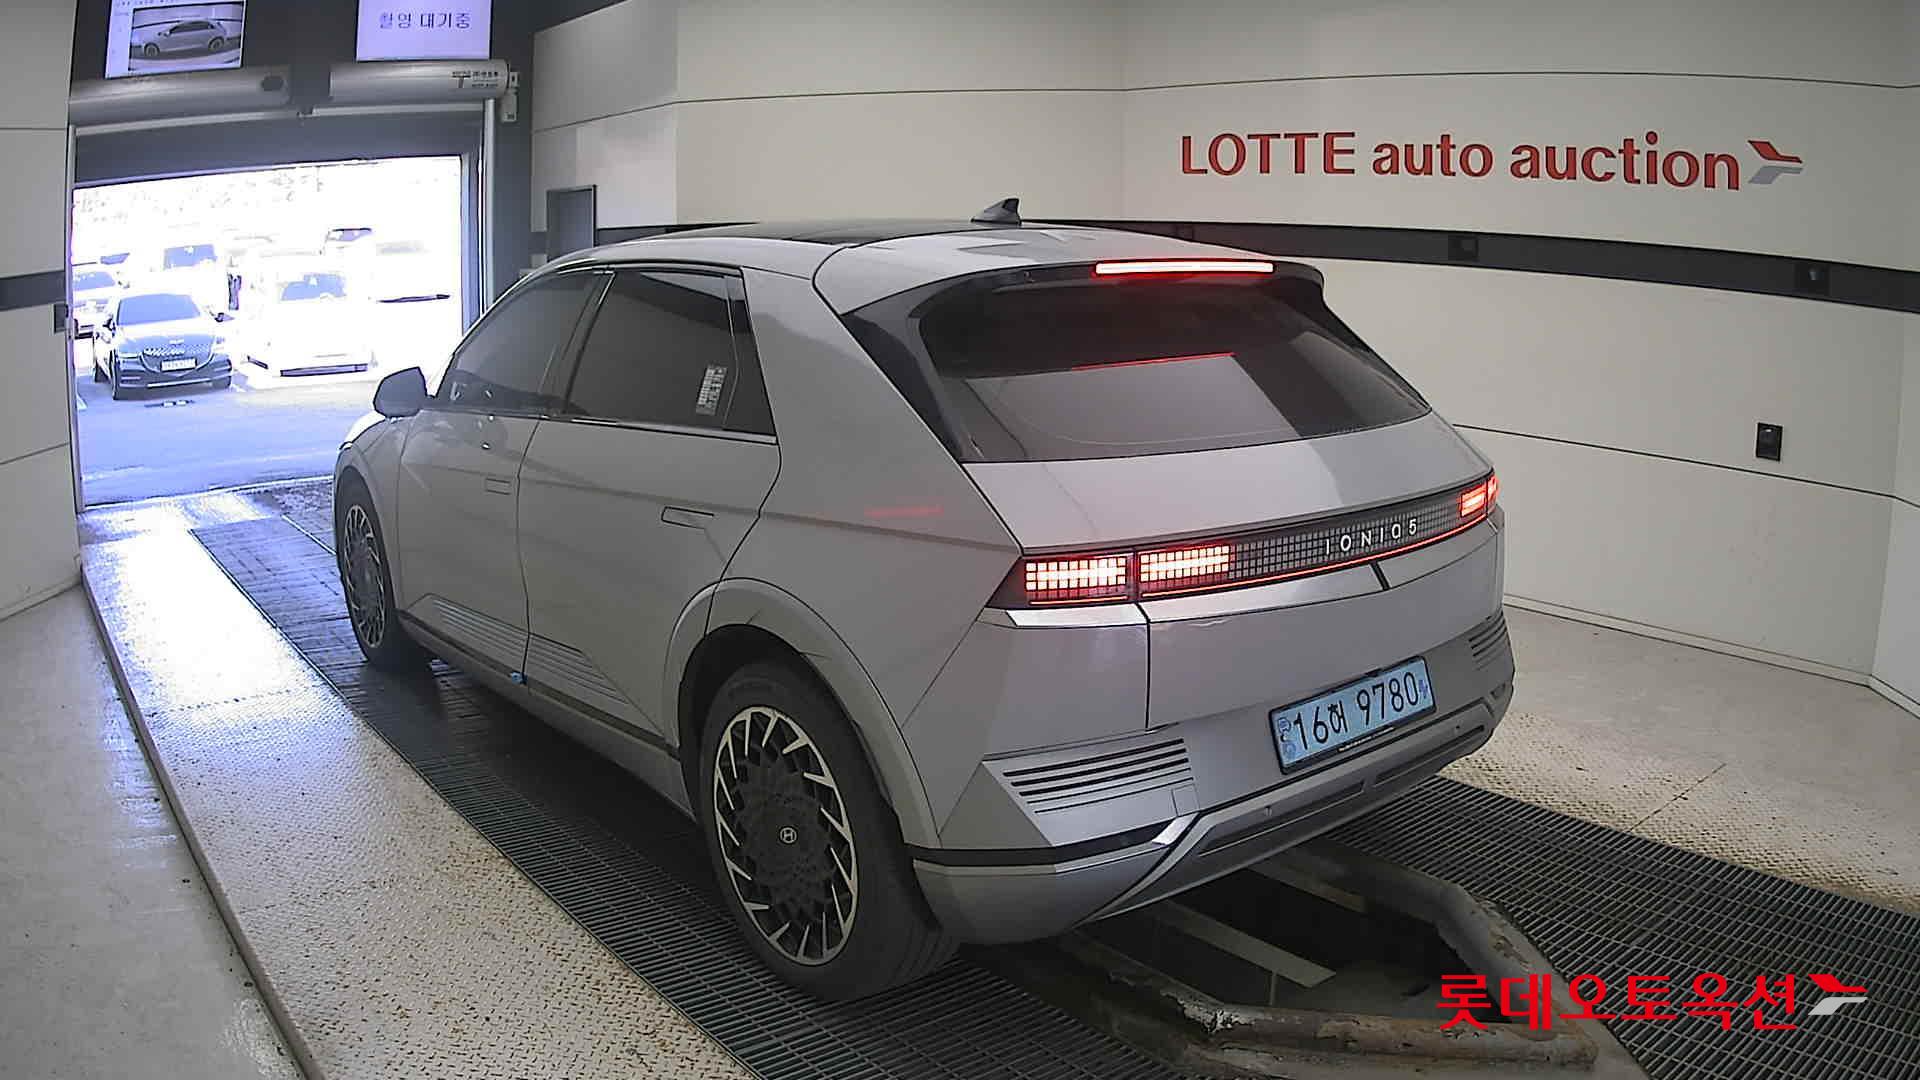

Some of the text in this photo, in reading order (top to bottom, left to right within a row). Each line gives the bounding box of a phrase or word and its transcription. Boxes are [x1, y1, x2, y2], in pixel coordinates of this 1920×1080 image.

[420, 12, 471, 29] 대기중
[1182, 131, 1740, 191] LOTTE auto auction
[1356, 671, 1419, 726] 9780
